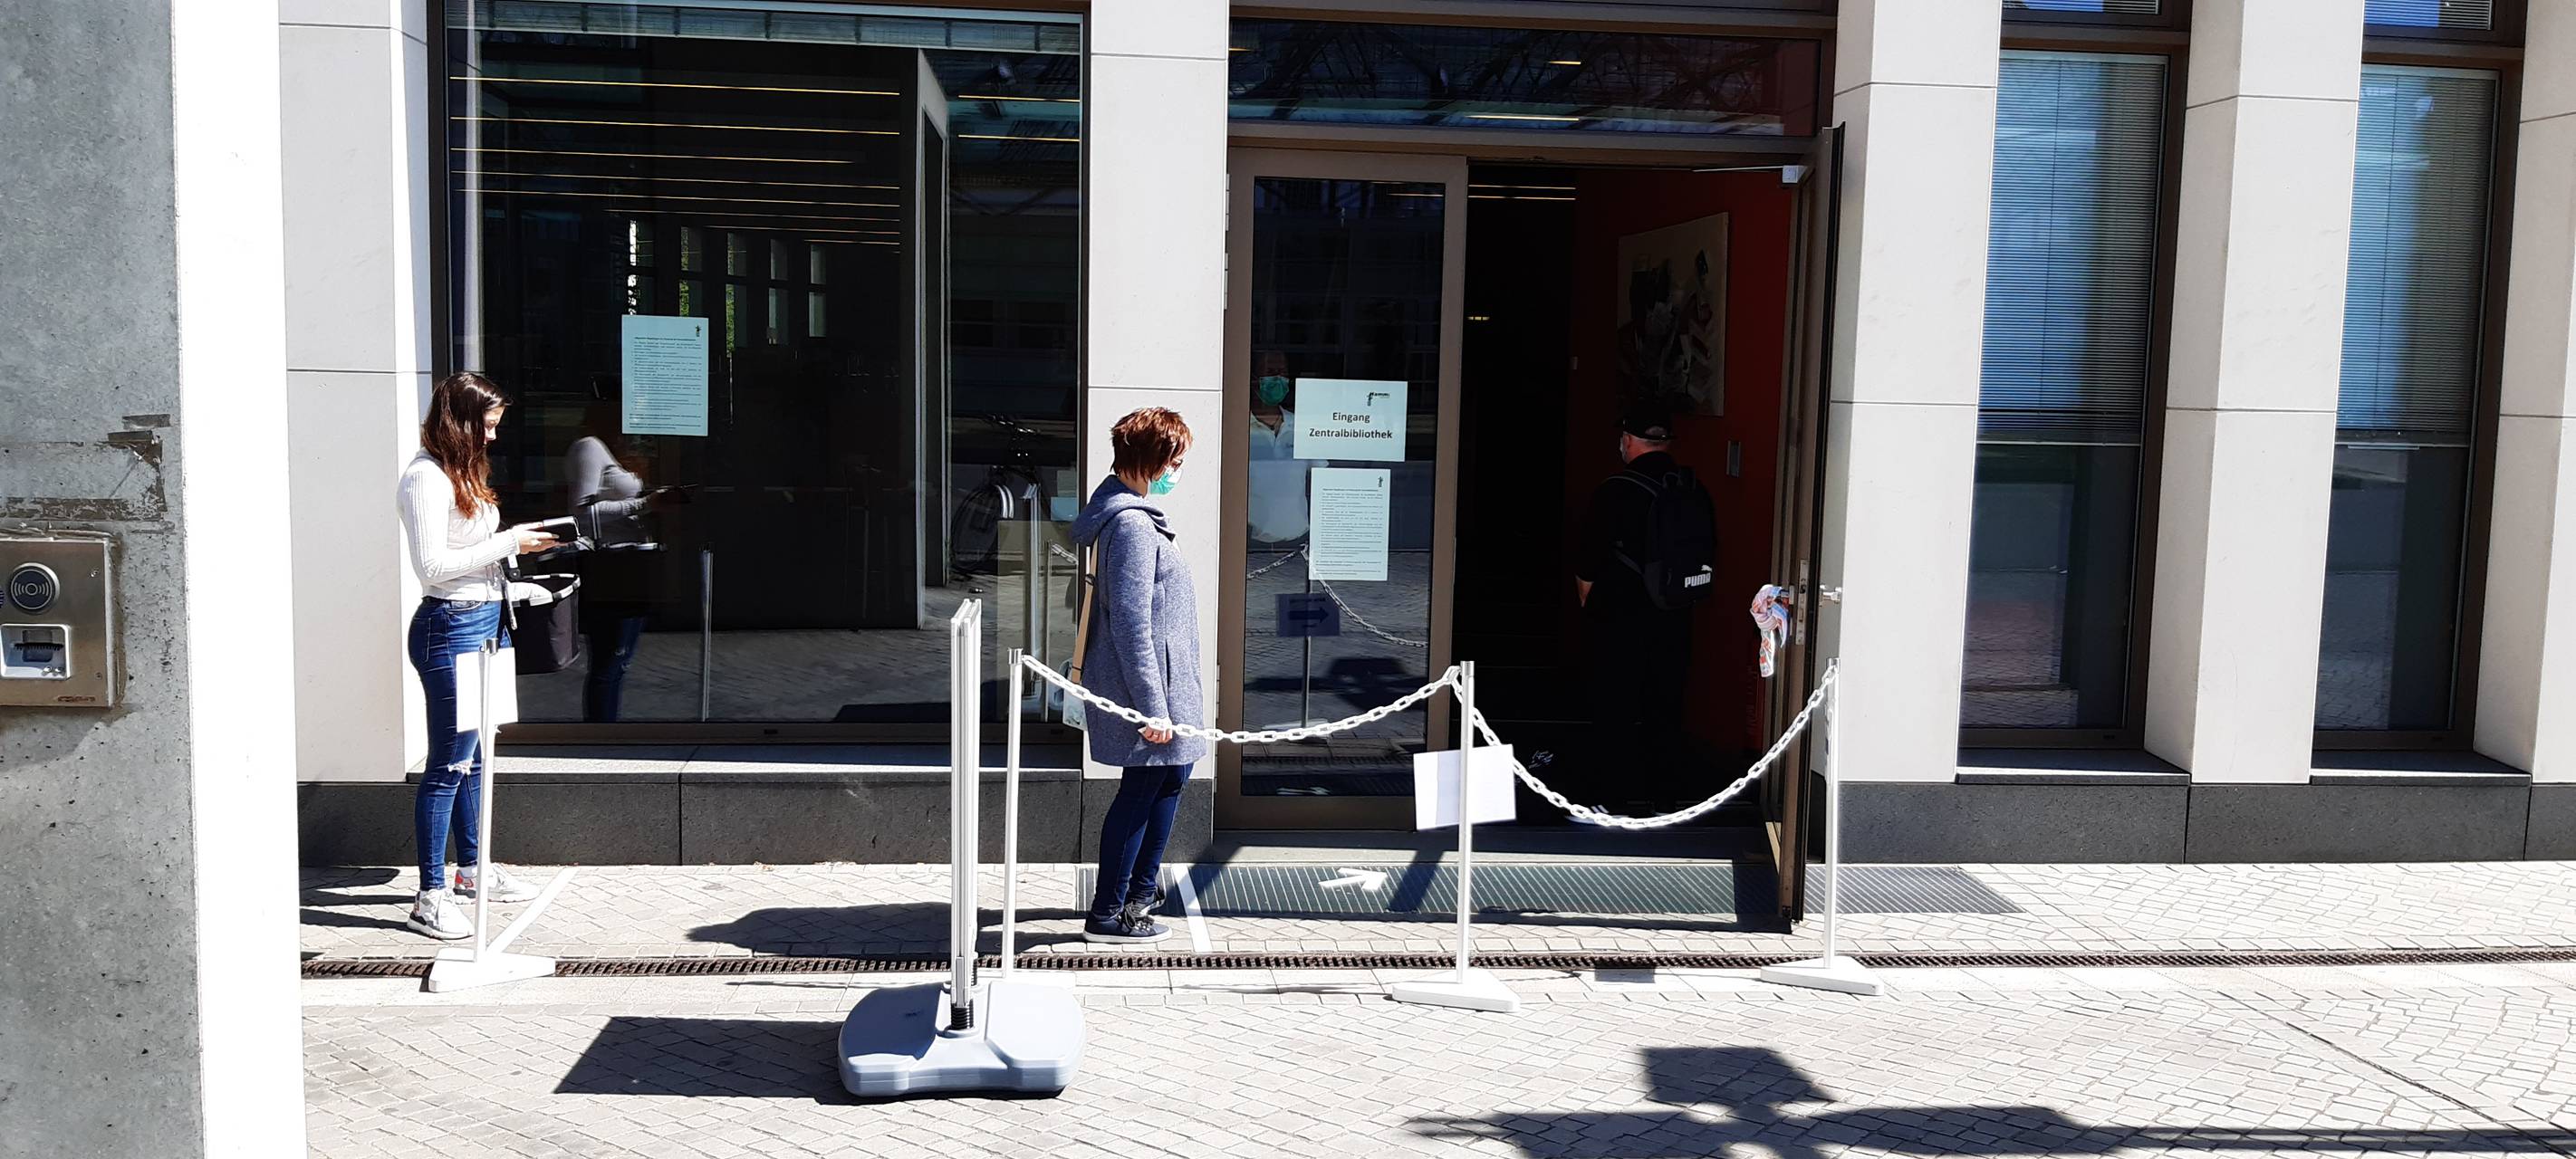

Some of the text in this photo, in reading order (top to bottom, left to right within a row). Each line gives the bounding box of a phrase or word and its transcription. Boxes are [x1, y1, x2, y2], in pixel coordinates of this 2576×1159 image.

[1332, 412, 1370, 423] Eingang
[1309, 428, 1393, 439] Zentralbibliothek
[1684, 572, 1711, 588] PUMA
